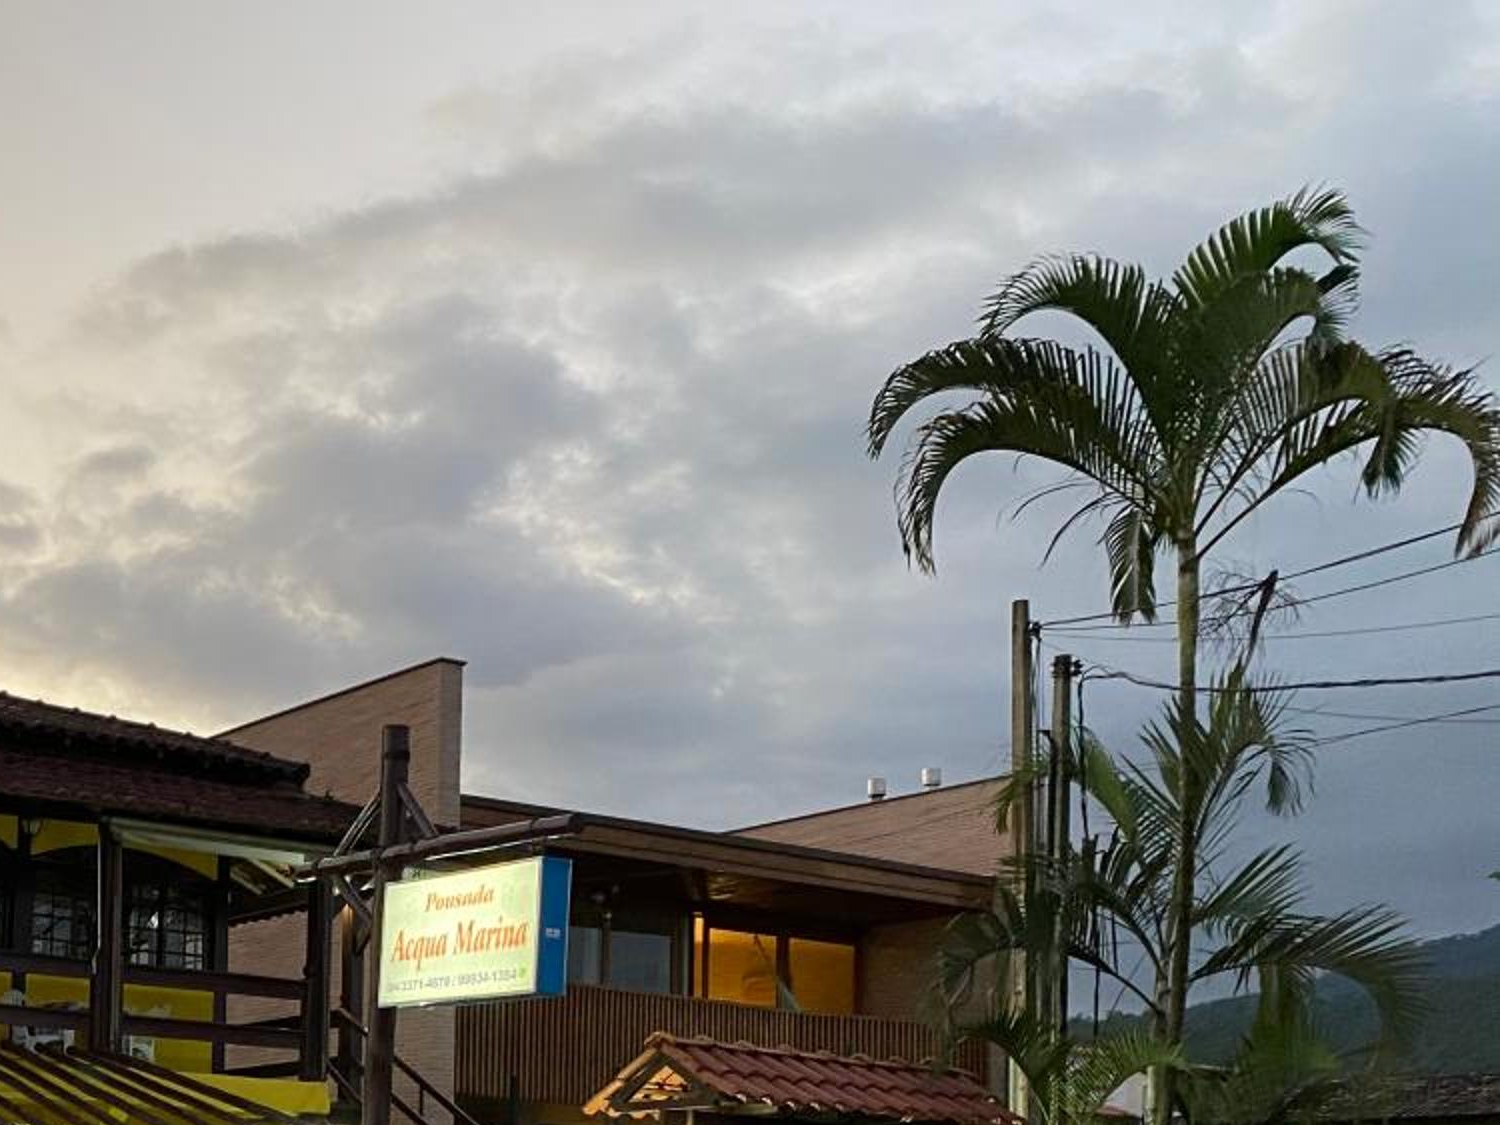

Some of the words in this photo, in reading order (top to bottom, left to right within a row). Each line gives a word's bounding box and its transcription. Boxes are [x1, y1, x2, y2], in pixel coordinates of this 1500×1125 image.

[424, 884, 495, 912] Pousada
[390, 928, 449, 970] Acqua
[453, 915, 529, 956] Marina
